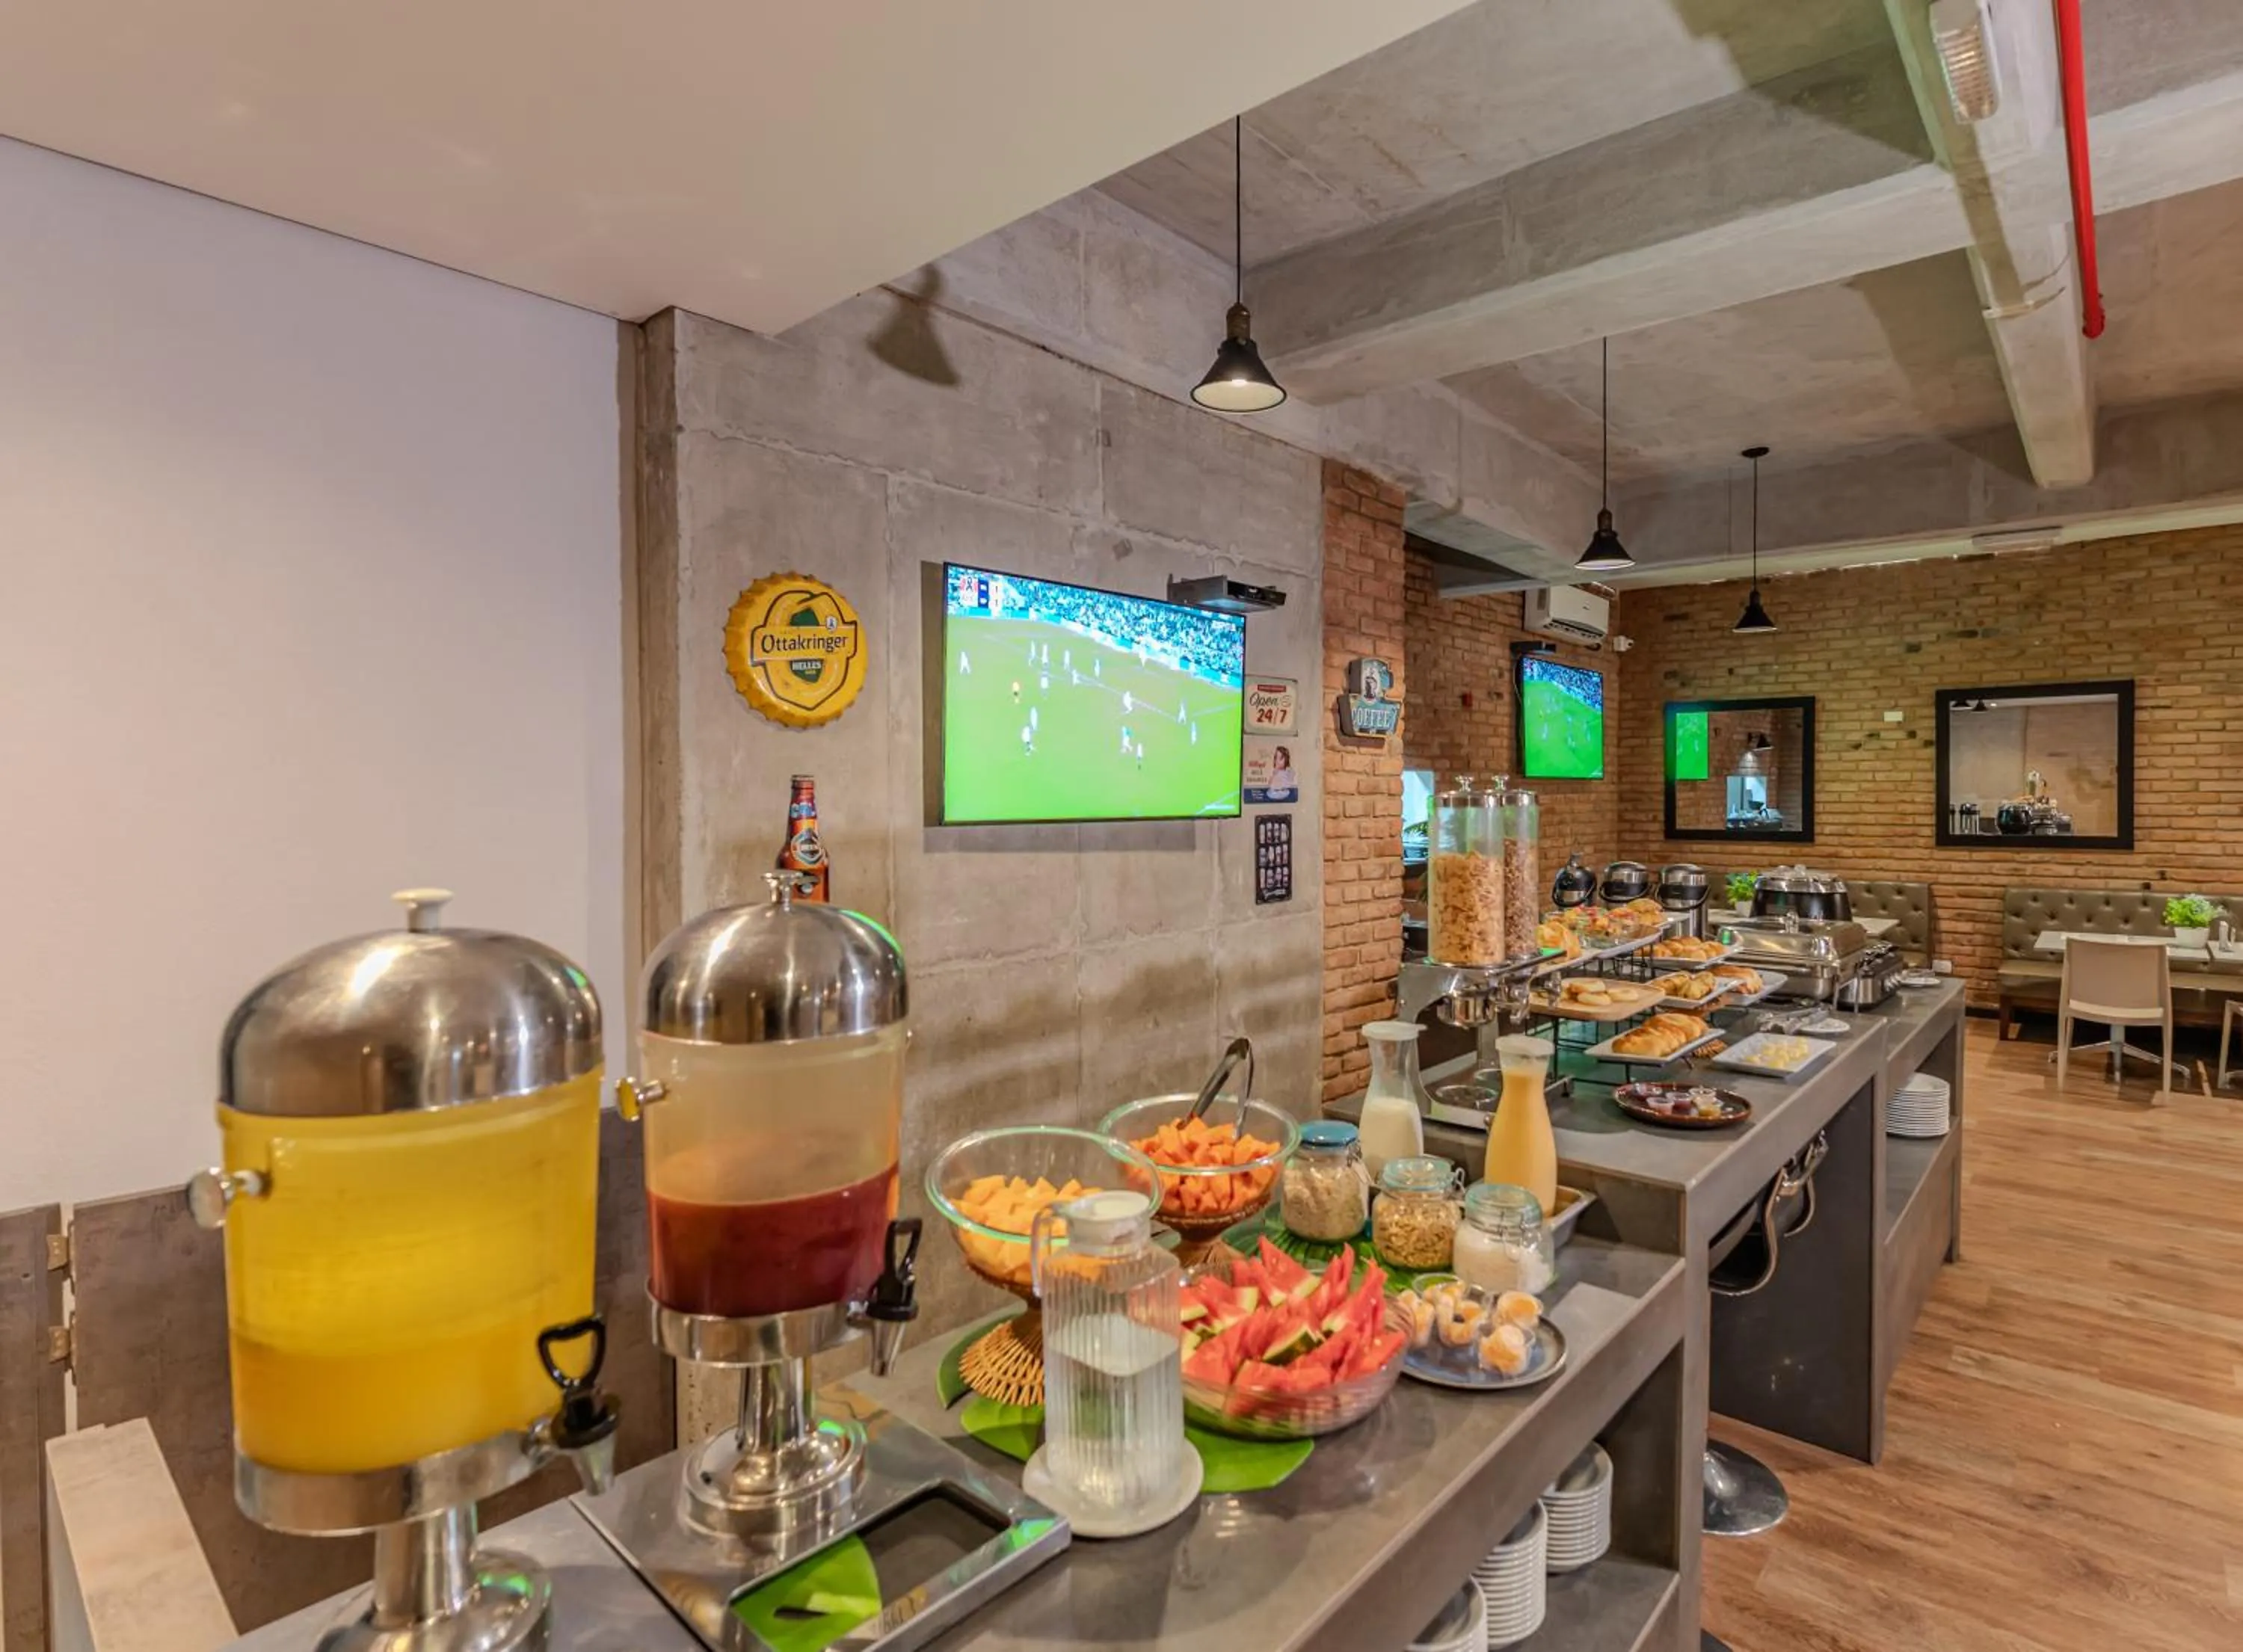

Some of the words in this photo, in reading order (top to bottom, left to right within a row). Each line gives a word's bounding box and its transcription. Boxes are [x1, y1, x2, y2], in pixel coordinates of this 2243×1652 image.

[761, 634, 849, 653] Ottakringer
[1249, 692, 1278, 709] Open
[1256, 707, 1287, 726] 24/7
[1351, 707, 1391, 728] COFFEE
